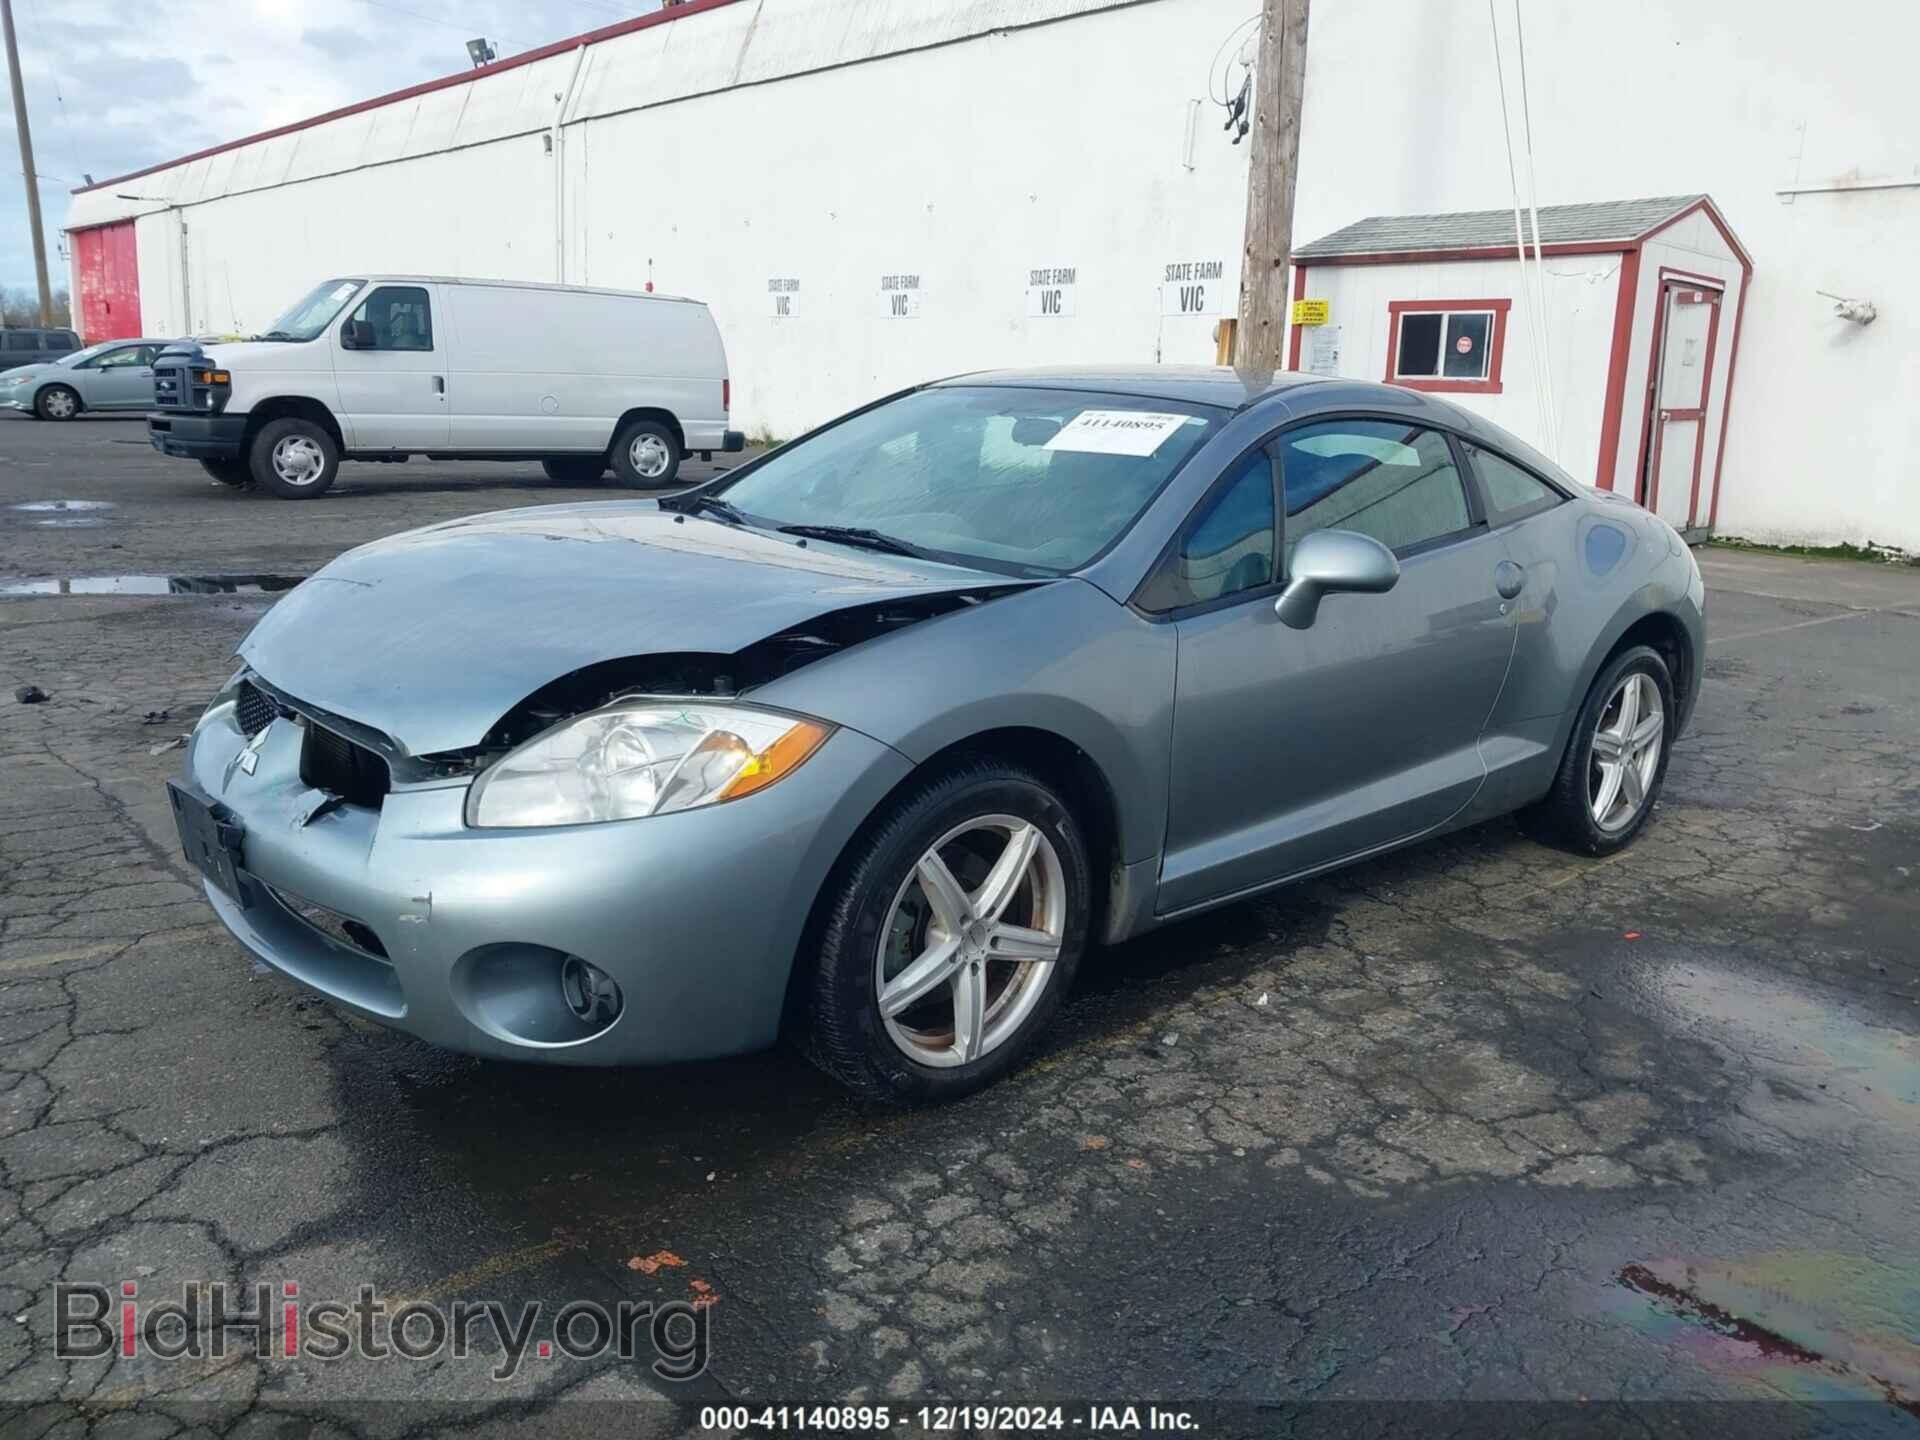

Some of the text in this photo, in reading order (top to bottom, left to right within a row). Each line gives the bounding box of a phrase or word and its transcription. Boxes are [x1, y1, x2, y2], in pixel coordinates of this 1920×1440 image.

[1030, 268, 1076, 286] STATE FARM
[1166, 261, 1223, 282] STATE FARM
[881, 275, 920, 290] STATE FARM
[776, 295, 790, 315] VIC
[891, 294, 908, 315] VIC
[1042, 289, 1061, 314] VIC
[1180, 285, 1204, 312] VIC
